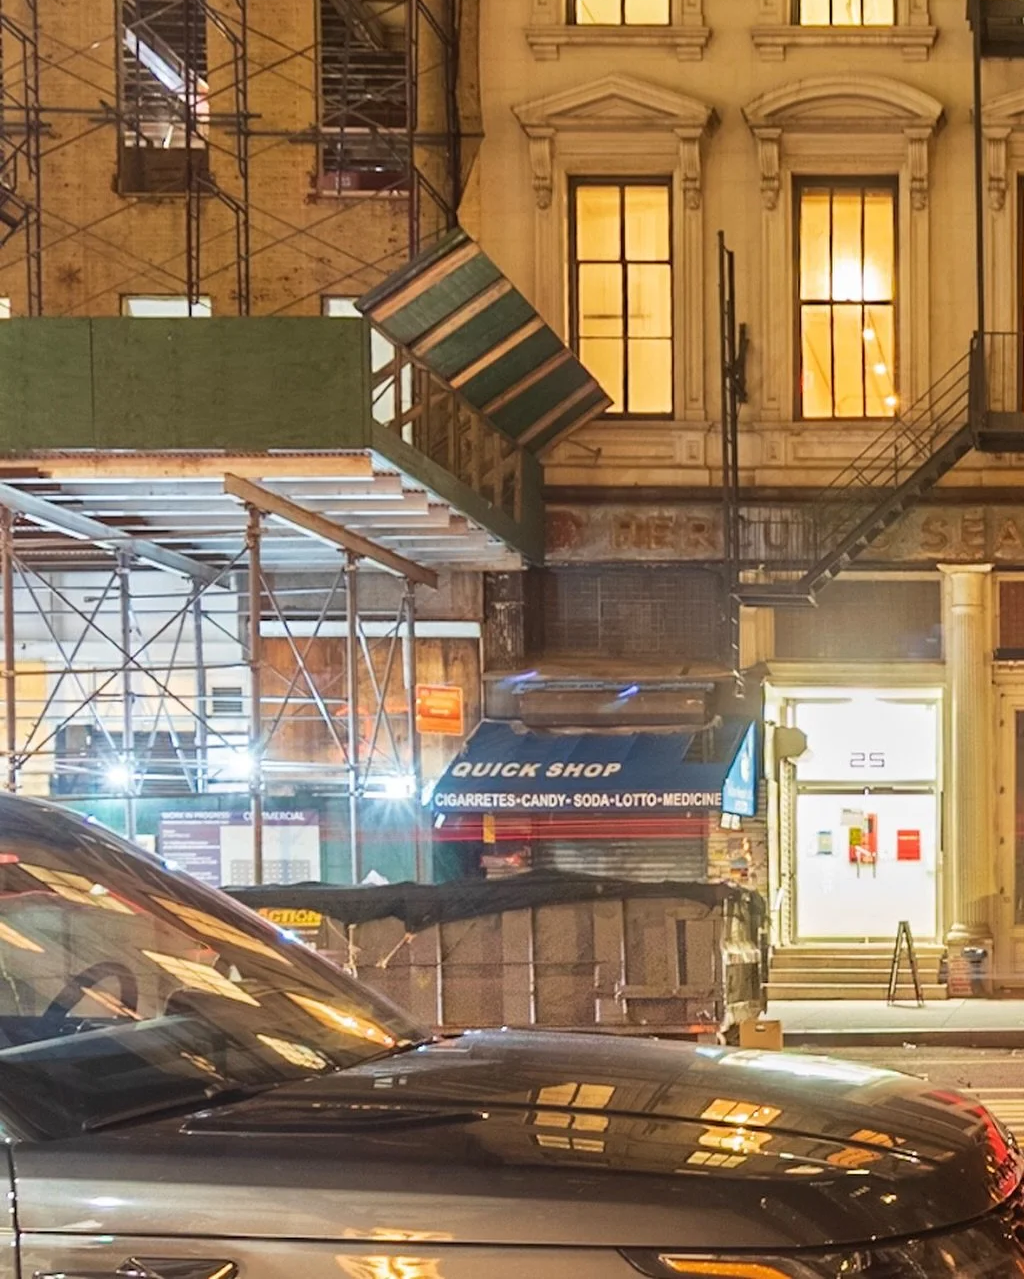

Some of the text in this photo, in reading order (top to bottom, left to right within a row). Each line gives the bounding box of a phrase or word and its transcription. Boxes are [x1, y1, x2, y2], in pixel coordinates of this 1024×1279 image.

[609, 513, 892, 553] HERCUL
[849, 751, 885, 768] 25
[451, 762, 622, 779] QUICK SHOP
[573, 792, 610, 808] SODA
[615, 792, 657, 808] LOTTO
